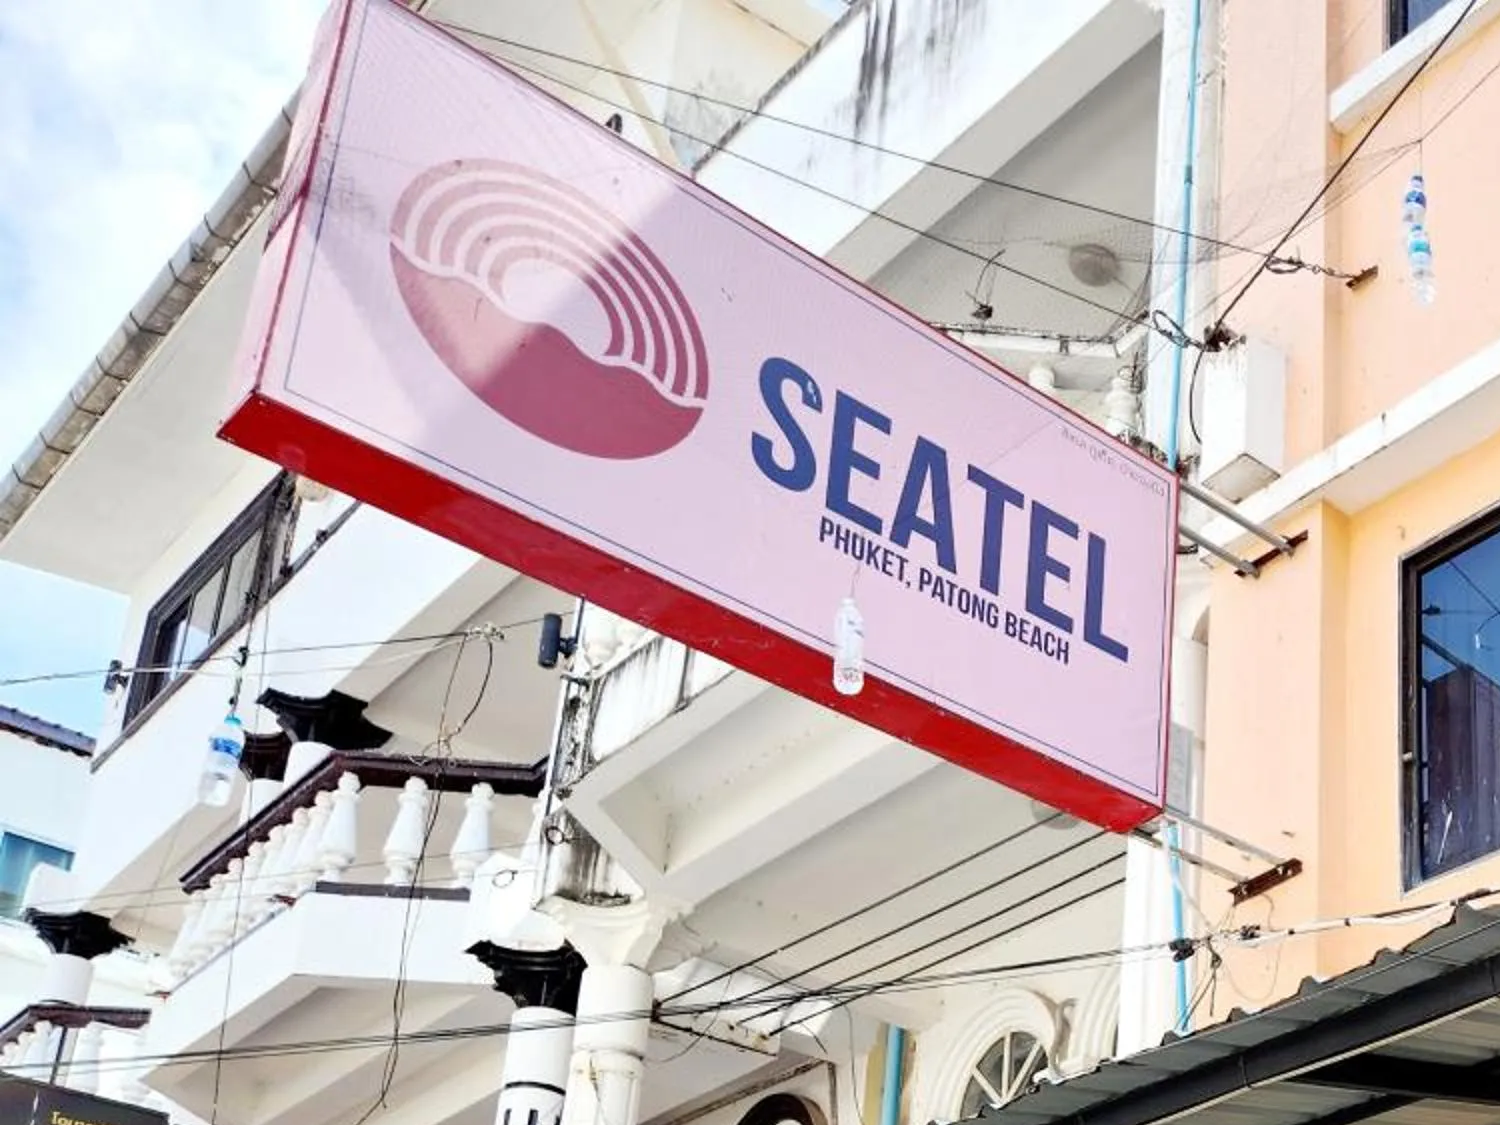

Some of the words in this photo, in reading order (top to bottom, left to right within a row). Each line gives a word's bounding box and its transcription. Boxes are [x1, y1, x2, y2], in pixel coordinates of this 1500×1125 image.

[752, 356, 1129, 663] SEATEL
[819, 516, 911, 588] PHUKET,
[918, 567, 1000, 630] PATONG
[1004, 611, 1070, 665] BEACH
